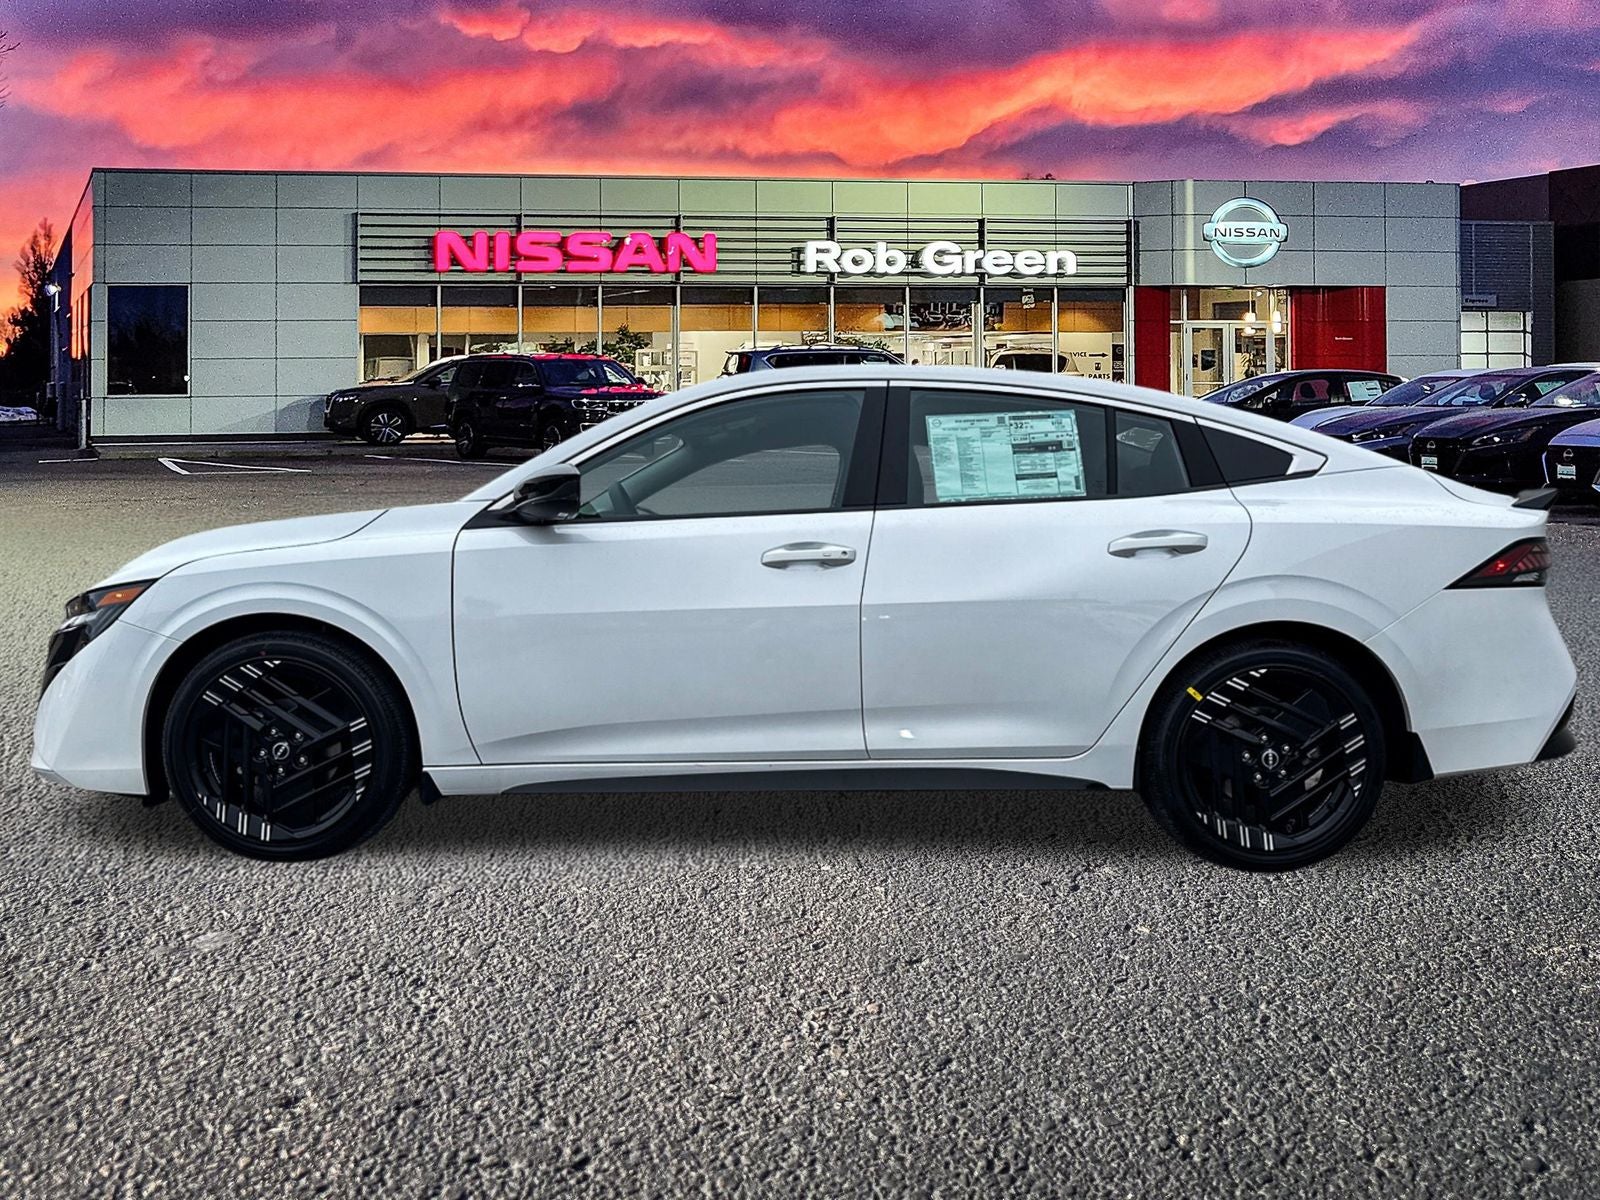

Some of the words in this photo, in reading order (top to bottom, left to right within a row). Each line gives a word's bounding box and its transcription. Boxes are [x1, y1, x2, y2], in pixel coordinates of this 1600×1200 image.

[1214, 227, 1280, 238] NISSAN
[434, 231, 718, 273] NISSAN
[804, 240, 907, 275] Rob
[921, 240, 1078, 275] Green
